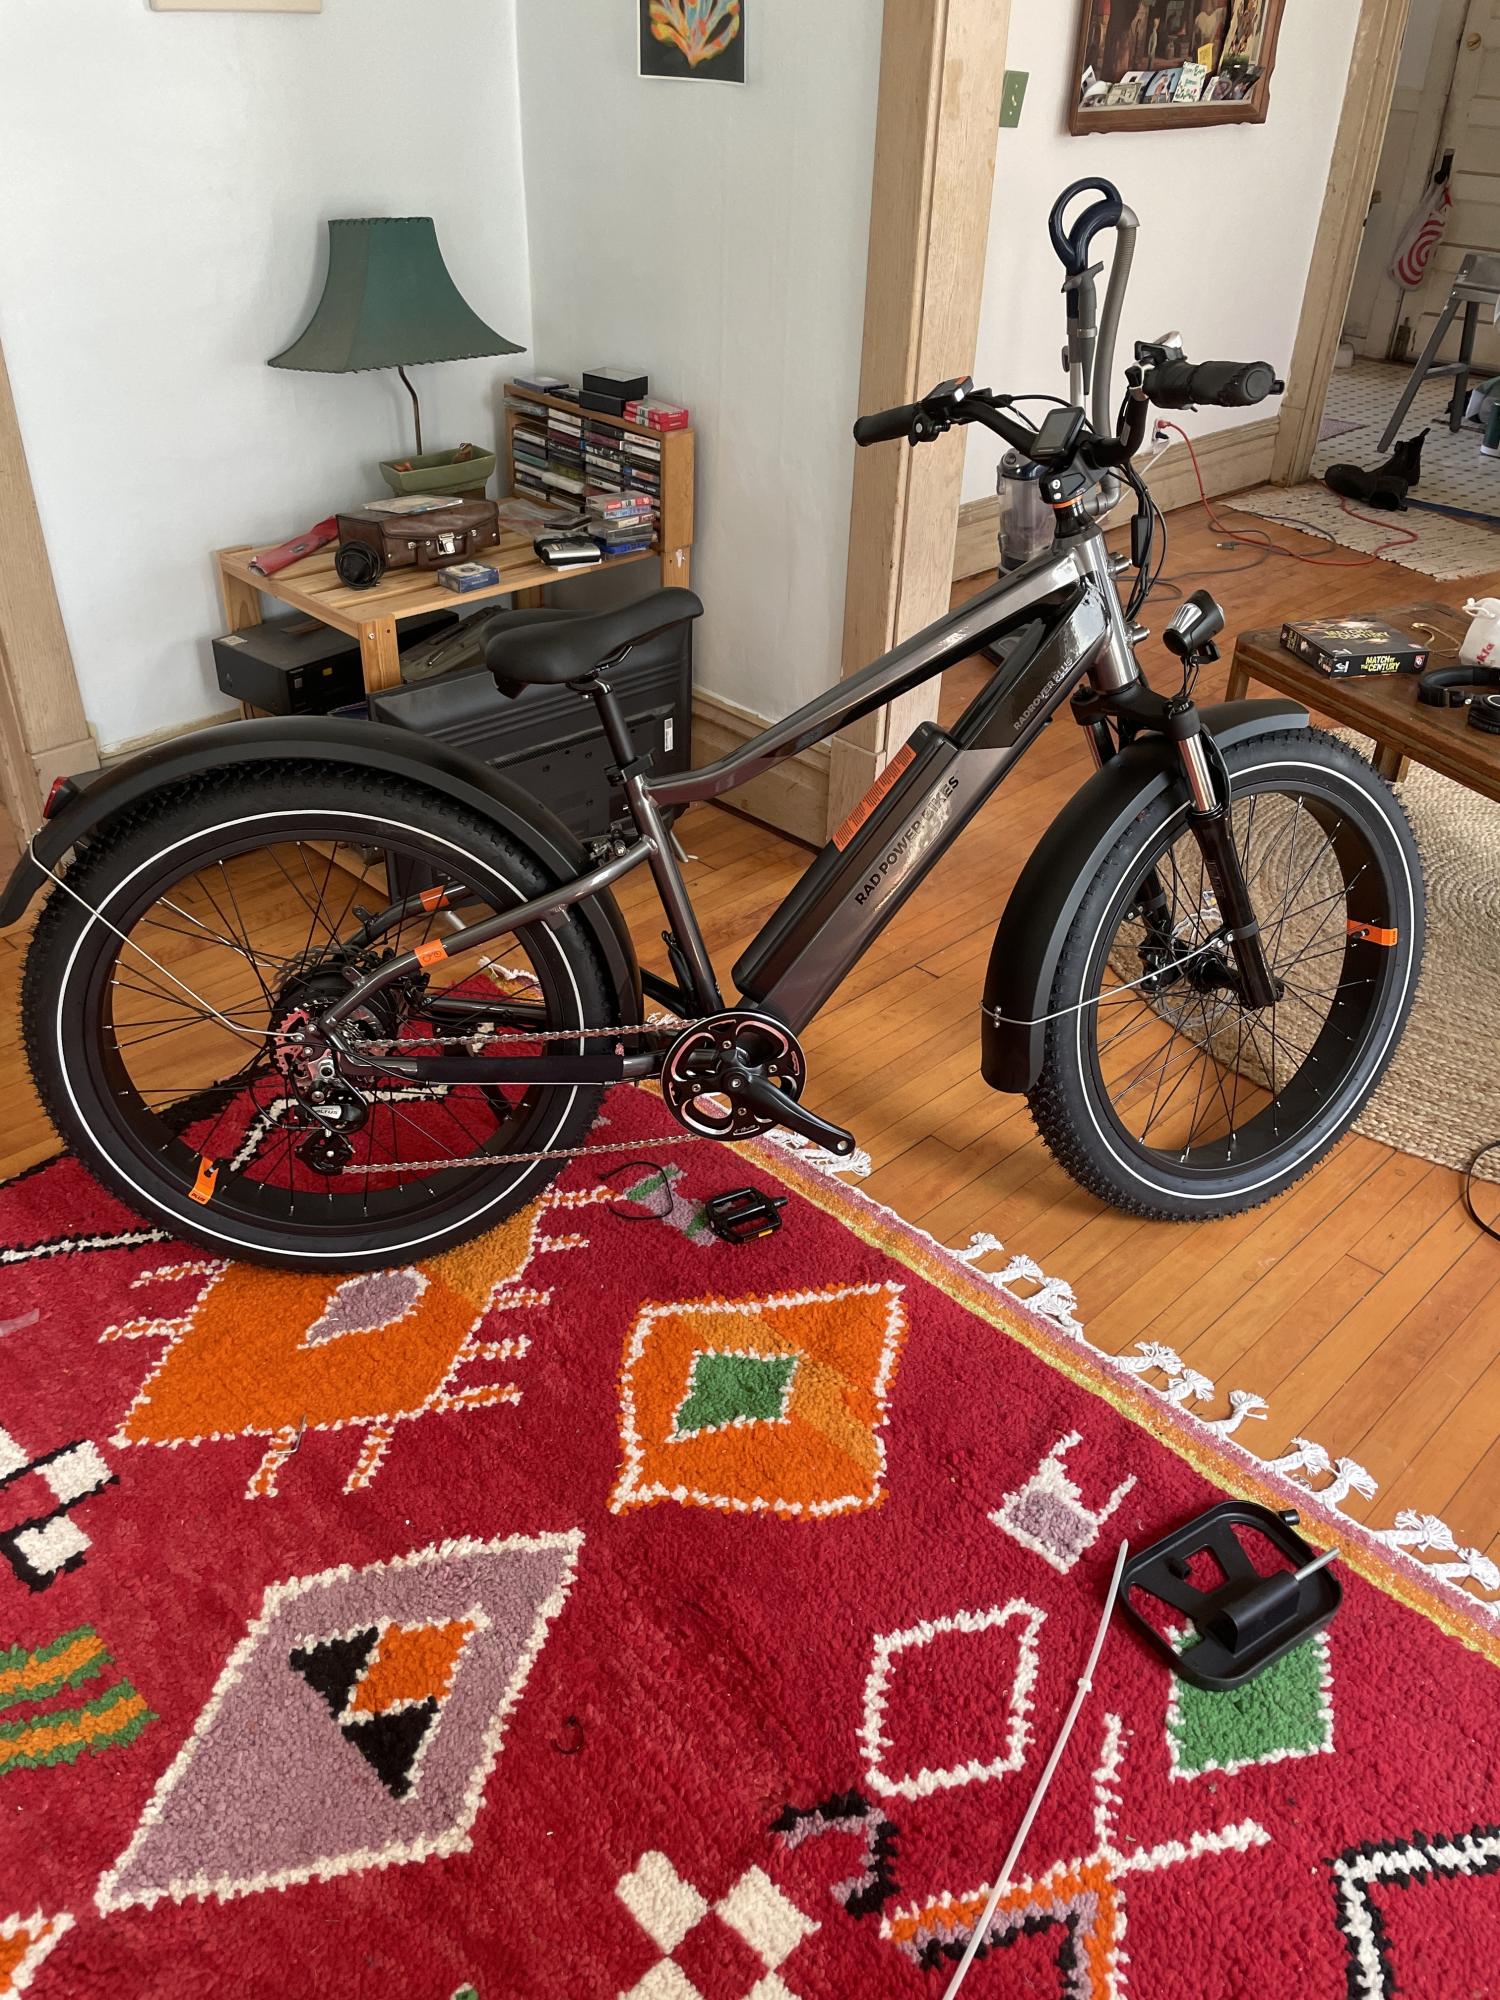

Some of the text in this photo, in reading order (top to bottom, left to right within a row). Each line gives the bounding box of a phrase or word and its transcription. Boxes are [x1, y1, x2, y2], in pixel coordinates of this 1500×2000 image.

[1365, 655, 1390, 664] MATCH
[1367, 661, 1401, 672] CENTURY
[1013, 657, 1073, 730] RADROVER PLUS
[854, 874, 882, 906] RAD
[878, 820, 925, 876] POWER
[921, 775, 960, 820] BIKES
